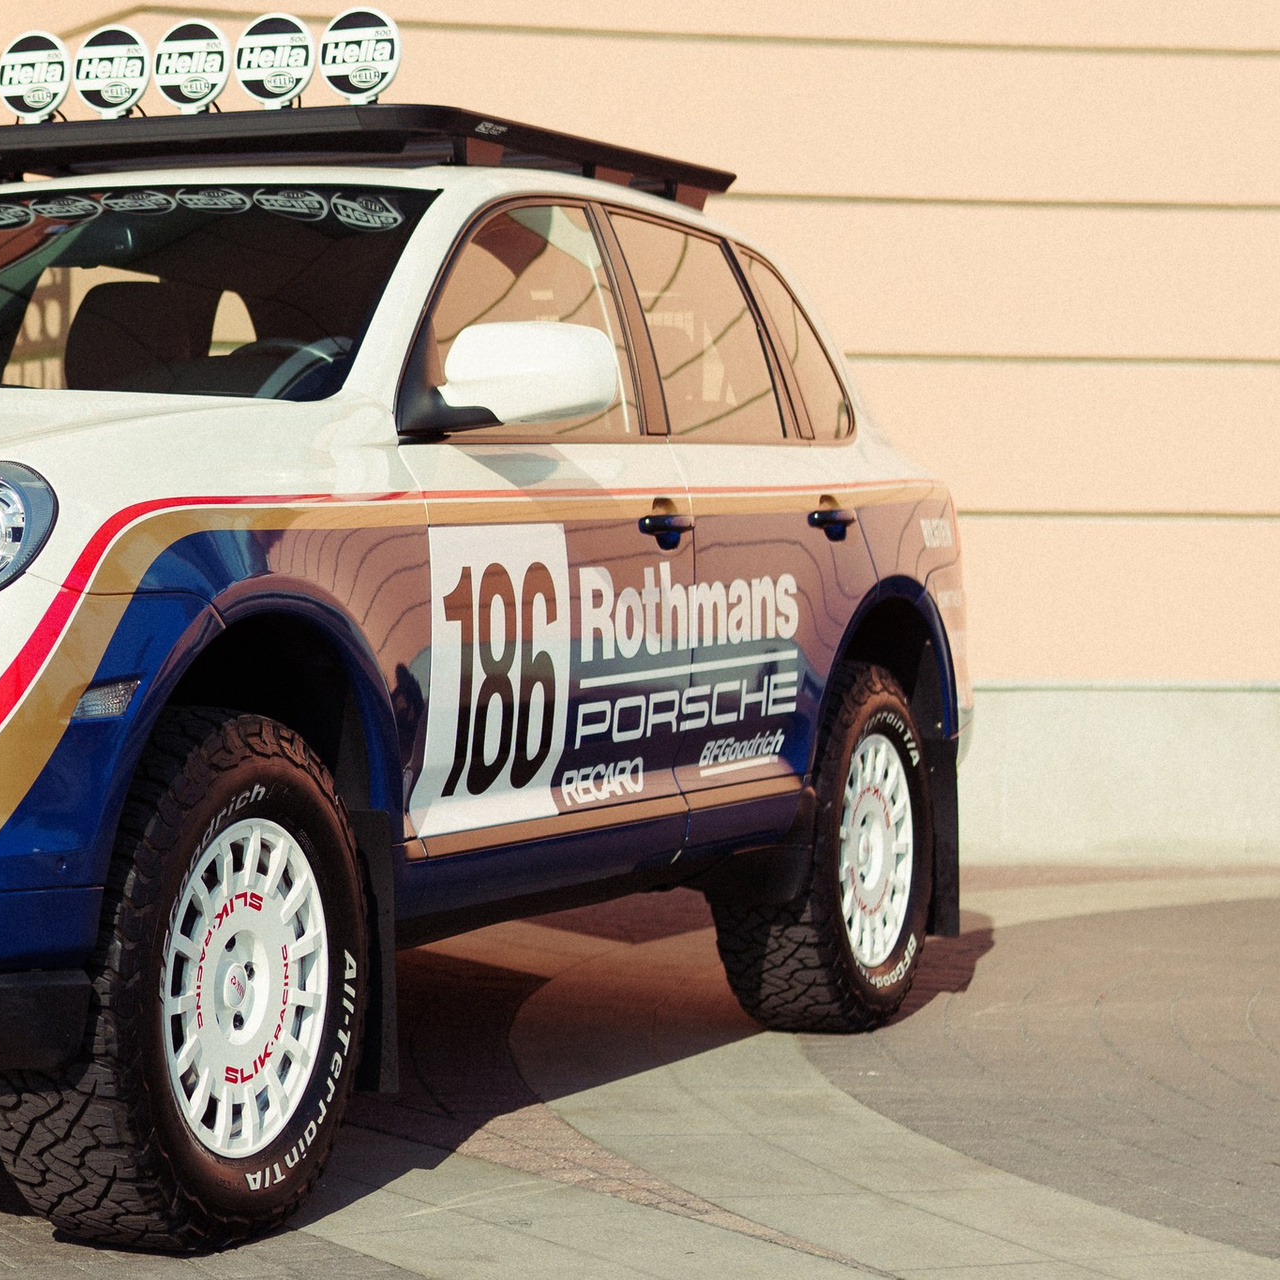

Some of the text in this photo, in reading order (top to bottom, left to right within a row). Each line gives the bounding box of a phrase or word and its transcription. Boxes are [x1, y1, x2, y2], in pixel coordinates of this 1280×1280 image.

[78, 56, 143, 80] Hella
[157, 51, 222, 74] Hella
[239, 45, 307, 69] Hella
[324, 39, 393, 65] Hella
[2, 61, 64, 86] Hella
[578, 561, 799, 663] Rothmans
[440, 561, 558, 798] 186
[574, 671, 799, 750] PORSCHE
[698, 728, 785, 767] BFGoodrich
[560, 756, 644, 807] RECARO
[214, 891, 264, 931] SLIK
[224, 1040, 275, 1085] SLIK
[244, 949, 358, 1192] All-Terrain T/A
